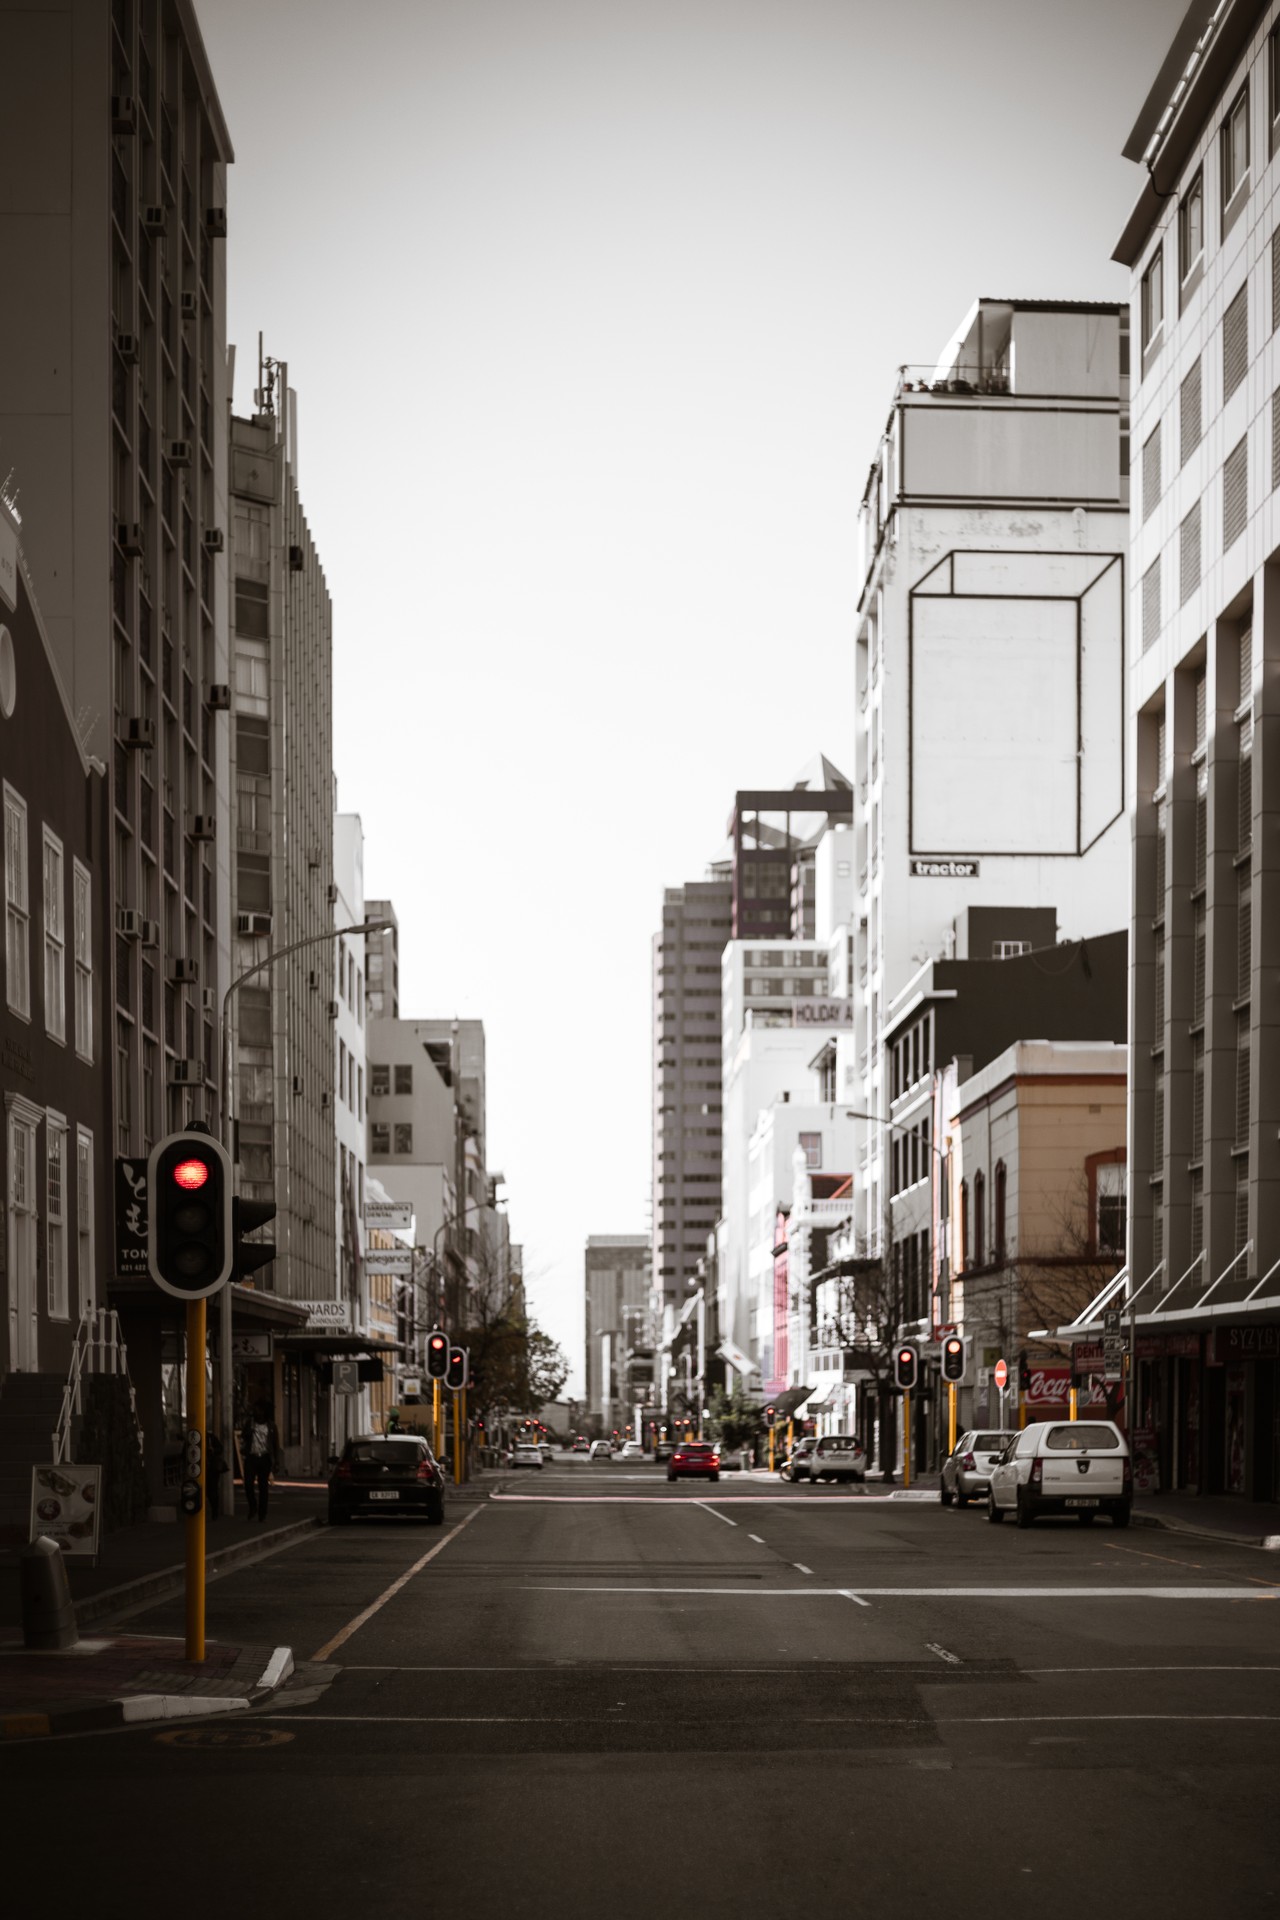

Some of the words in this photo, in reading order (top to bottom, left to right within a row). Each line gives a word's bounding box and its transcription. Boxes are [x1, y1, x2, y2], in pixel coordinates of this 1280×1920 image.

[916, 861, 973, 875] tractor
[797, 1004, 841, 1021] HOLIDAY
[366, 1254, 410, 1264] elegance
[1108, 1314, 1117, 1326] P
[1230, 1328, 1280, 1354] SYZYGY
[340, 1365, 351, 1378] P
